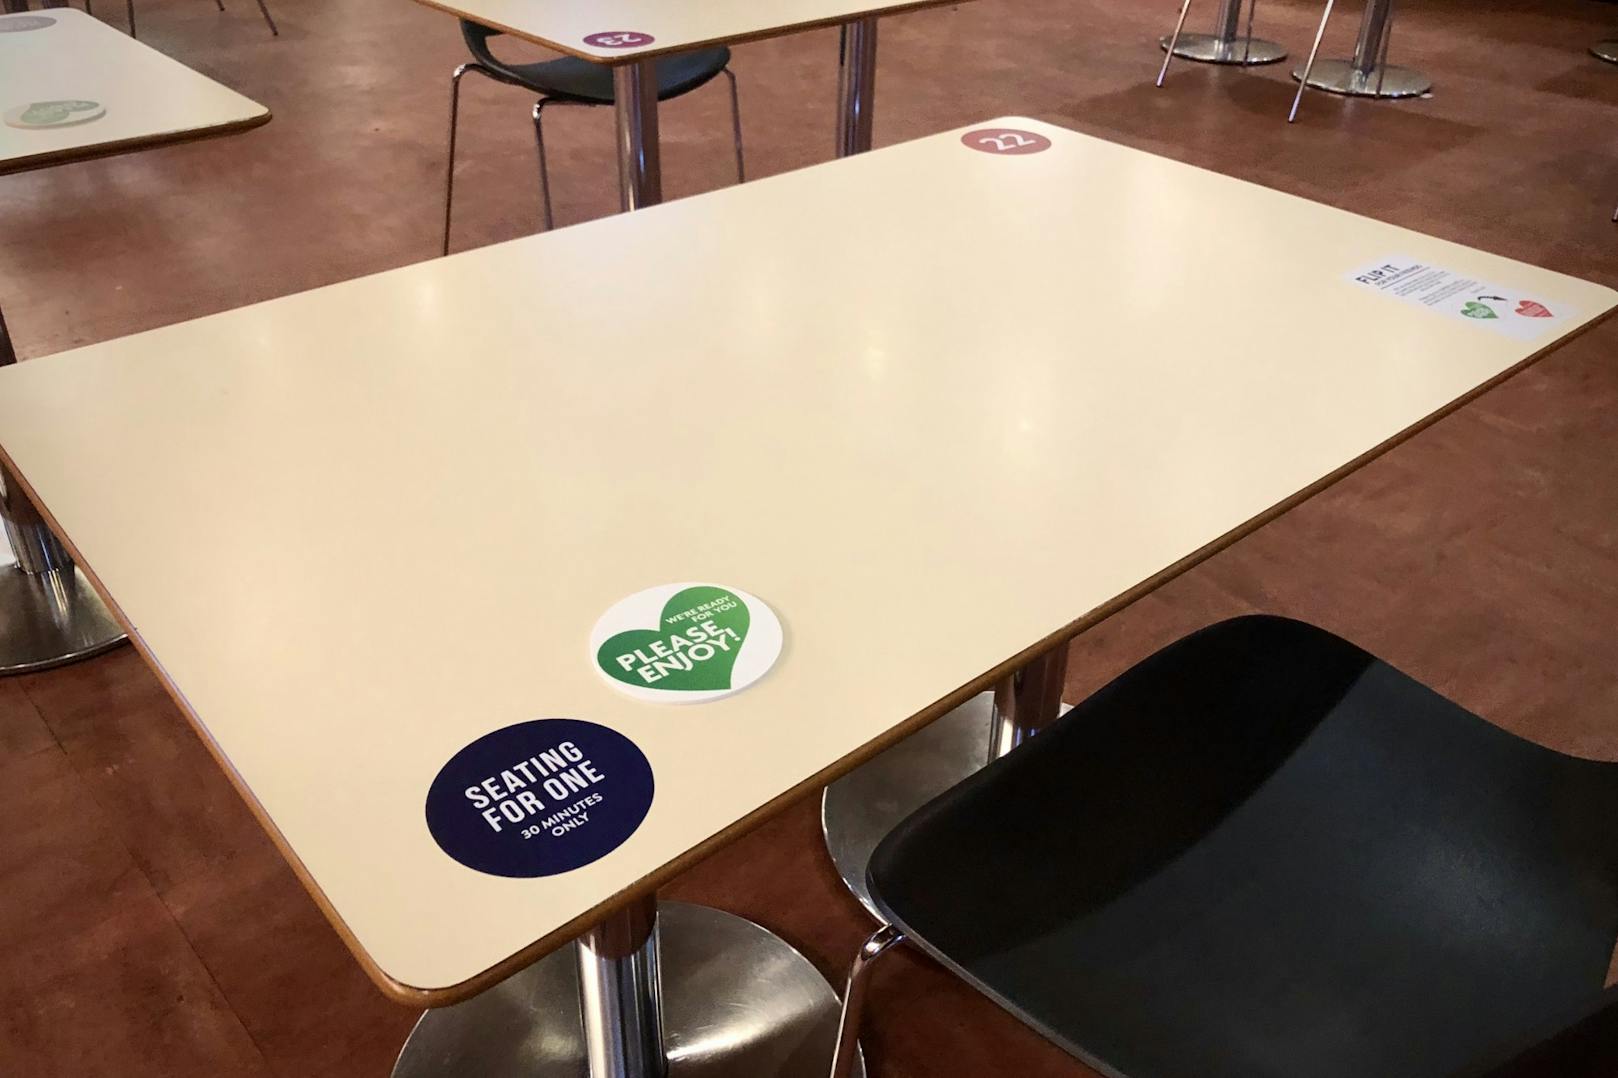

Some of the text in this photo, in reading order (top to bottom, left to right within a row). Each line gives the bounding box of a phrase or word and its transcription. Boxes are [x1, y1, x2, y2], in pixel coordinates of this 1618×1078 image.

[597, 34, 642, 46] 23
[978, 133, 1036, 151] 22
[1355, 270, 1386, 285] FLIP
[1380, 264, 1400, 274] IT
[665, 595, 731, 625] WE'RE READY
[692, 601, 737, 623] FOR YOU
[615, 620, 724, 672] PLEASE
[636, 627, 741, 684] ENJOY!
[464, 741, 584, 809] SEATING
[481, 760, 606, 833] FOR ONE
[520, 792, 604, 840] 30 MINUTES
[551, 811, 590, 837] ONLY
